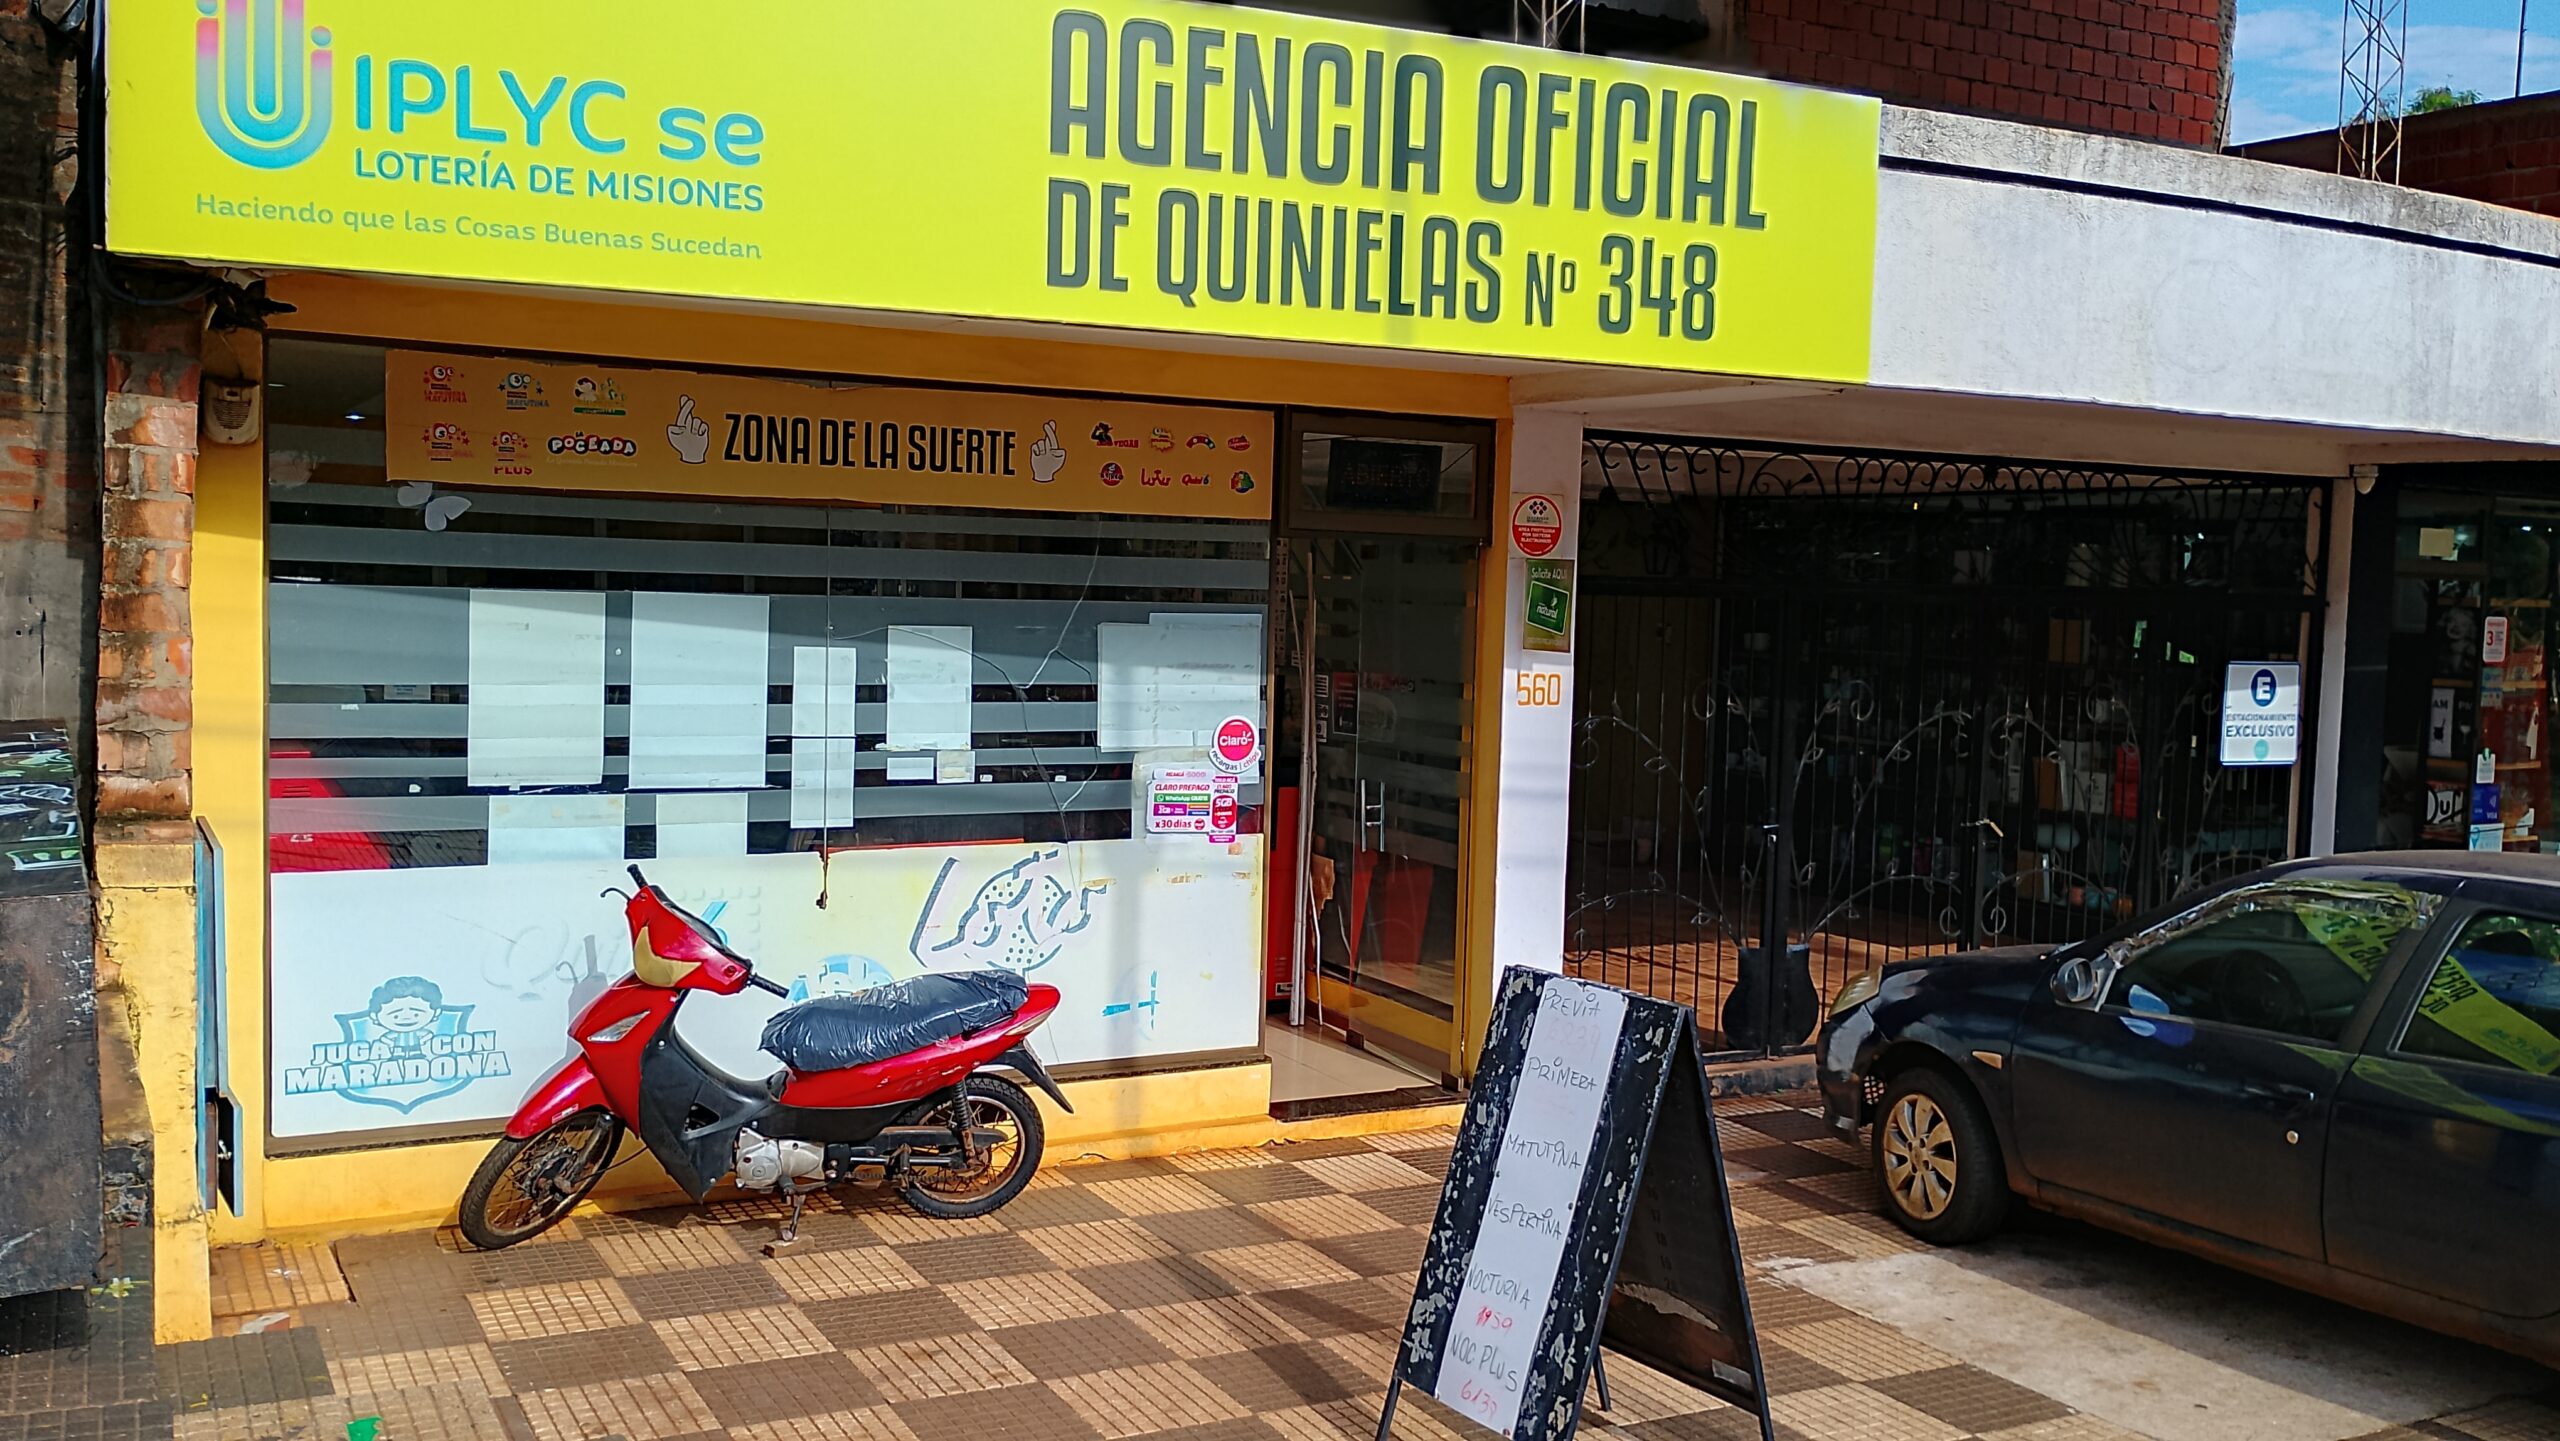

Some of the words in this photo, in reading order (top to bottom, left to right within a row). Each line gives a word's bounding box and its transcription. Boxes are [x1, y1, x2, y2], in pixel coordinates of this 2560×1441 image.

[355, 54, 627, 153] IPLYC
[657, 105, 767, 166] se
[1049, 8, 1446, 196] AGENCIA
[1475, 64, 1769, 231] OFICIAL
[355, 148, 517, 193] LOTERÍA
[528, 163, 575, 197] DE
[586, 168, 766, 213] MISIONES
[195, 191, 335, 227] Haciendo
[342, 208, 396, 234] que
[403, 207, 448, 236] las
[455, 214, 538, 243] Cosas
[543, 222, 644, 253] Buenas
[651, 231, 763, 261] Sucedan
[1046, 176, 1132, 294] DE
[1155, 187, 1504, 326] QUINIELAS
[1598, 231, 1719, 344] 348
[549, 435, 636, 456] POCEADA
[723, 412, 814, 468] ZONA
[818, 418, 858, 470] DE
[862, 420, 900, 472] LA
[906, 422, 1018, 477] SUERTE
[1517, 672, 1562, 708] 560
[2433, 699, 2448, 710] AM
[2225, 725, 2296, 738] EXCLUSIVO
[2226, 713, 2297, 722] ESTACIONAMIENTO
[1219, 732, 1250, 747] Claro
[1211, 750, 1239, 771] recargas
[1154, 783, 1178, 792] CLARO
[1178, 783, 1211, 792] PREPAGO
[1165, 794, 1190, 802] WhatsApp
[1541, 987, 1601, 1017] PREVIA
[430, 1029, 498, 1058] CON
[284, 1050, 512, 1096] MARADONA
[1505, 1133, 1582, 1169] MATUTINA
[1486, 1193, 1563, 1241] VESPERTINA
[1465, 1263, 1531, 1311] NOCTURNA
[1478, 1344, 1519, 1393] PLUS
